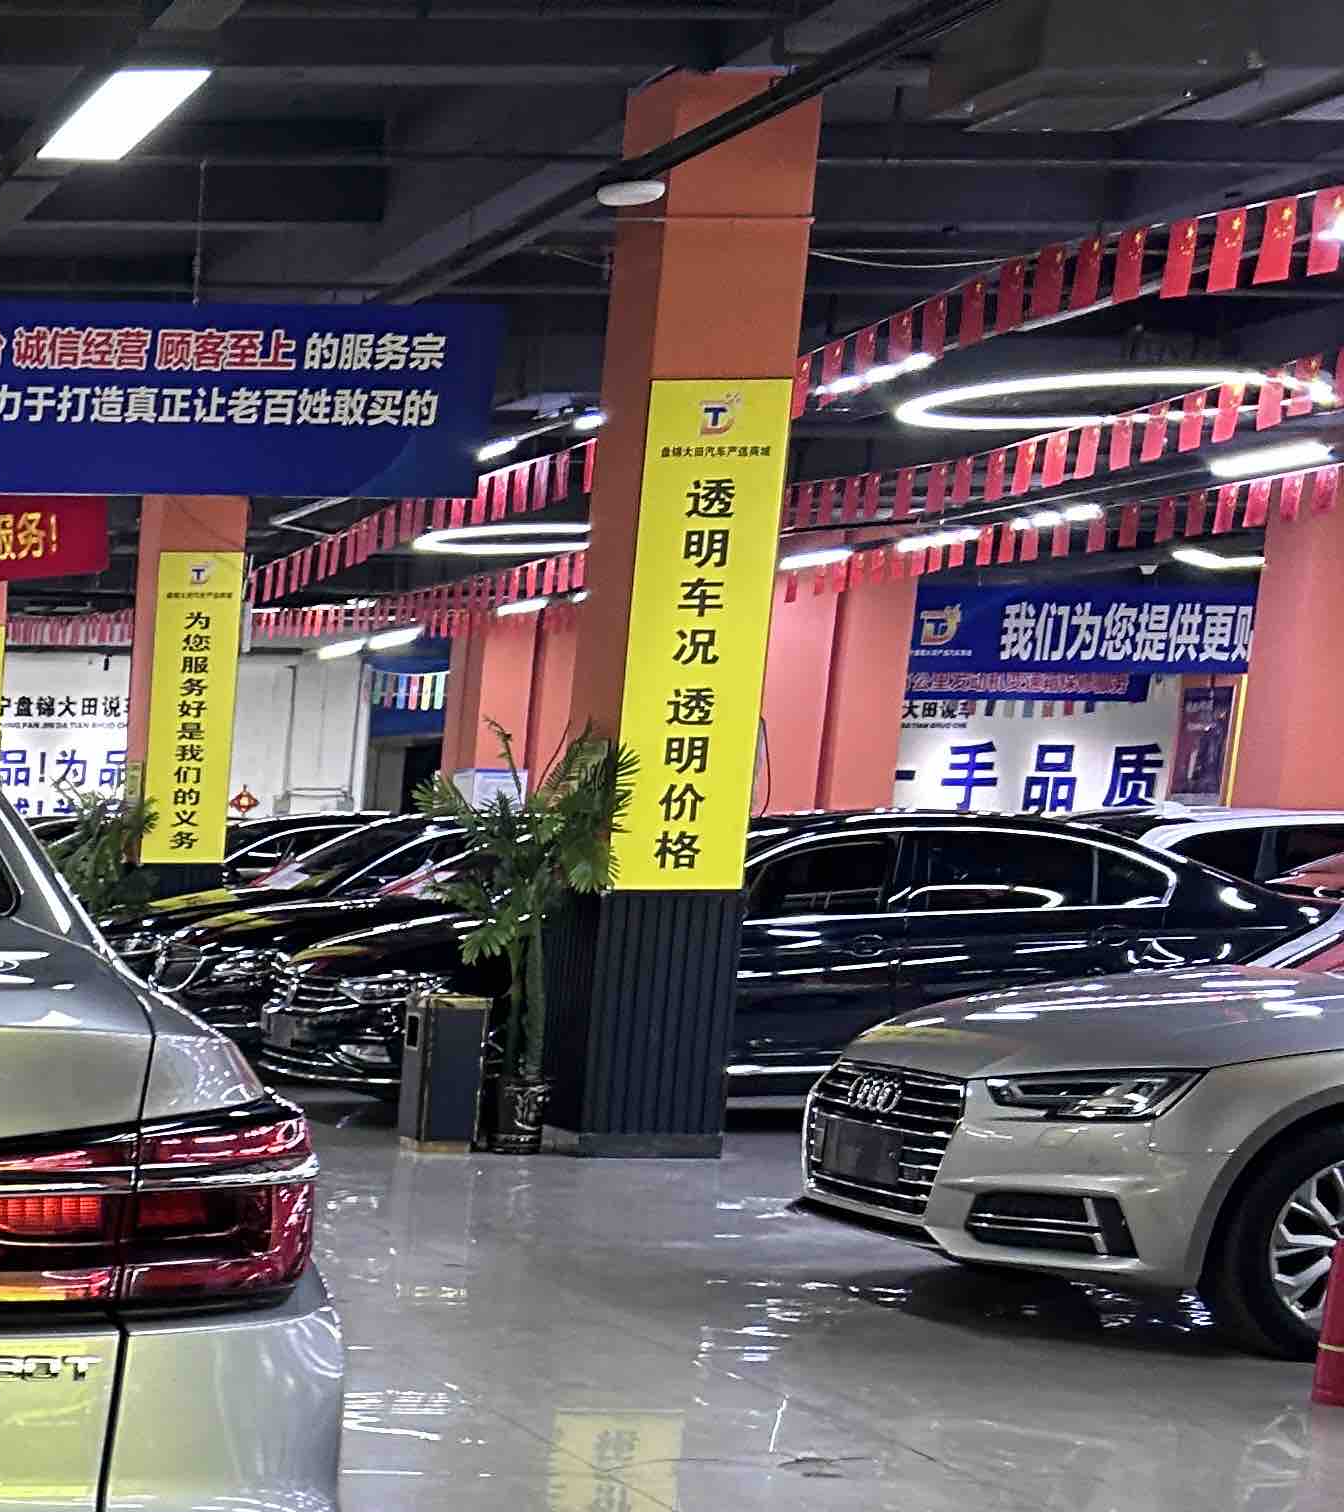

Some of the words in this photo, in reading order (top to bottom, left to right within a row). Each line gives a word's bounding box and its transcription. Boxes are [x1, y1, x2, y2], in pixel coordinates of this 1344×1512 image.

[12, 327, 151, 370] 诚信经营
[155, 328, 297, 371] 顾客至上
[304, 332, 446, 371] 的服务宗
[671, 478, 737, 665] 透明车况
[0, 696, 129, 718] 宁盘锦大田说
[169, 611, 211, 851] 为您服务好是我们的义务
[655, 687, 715, 870] 透明价格
